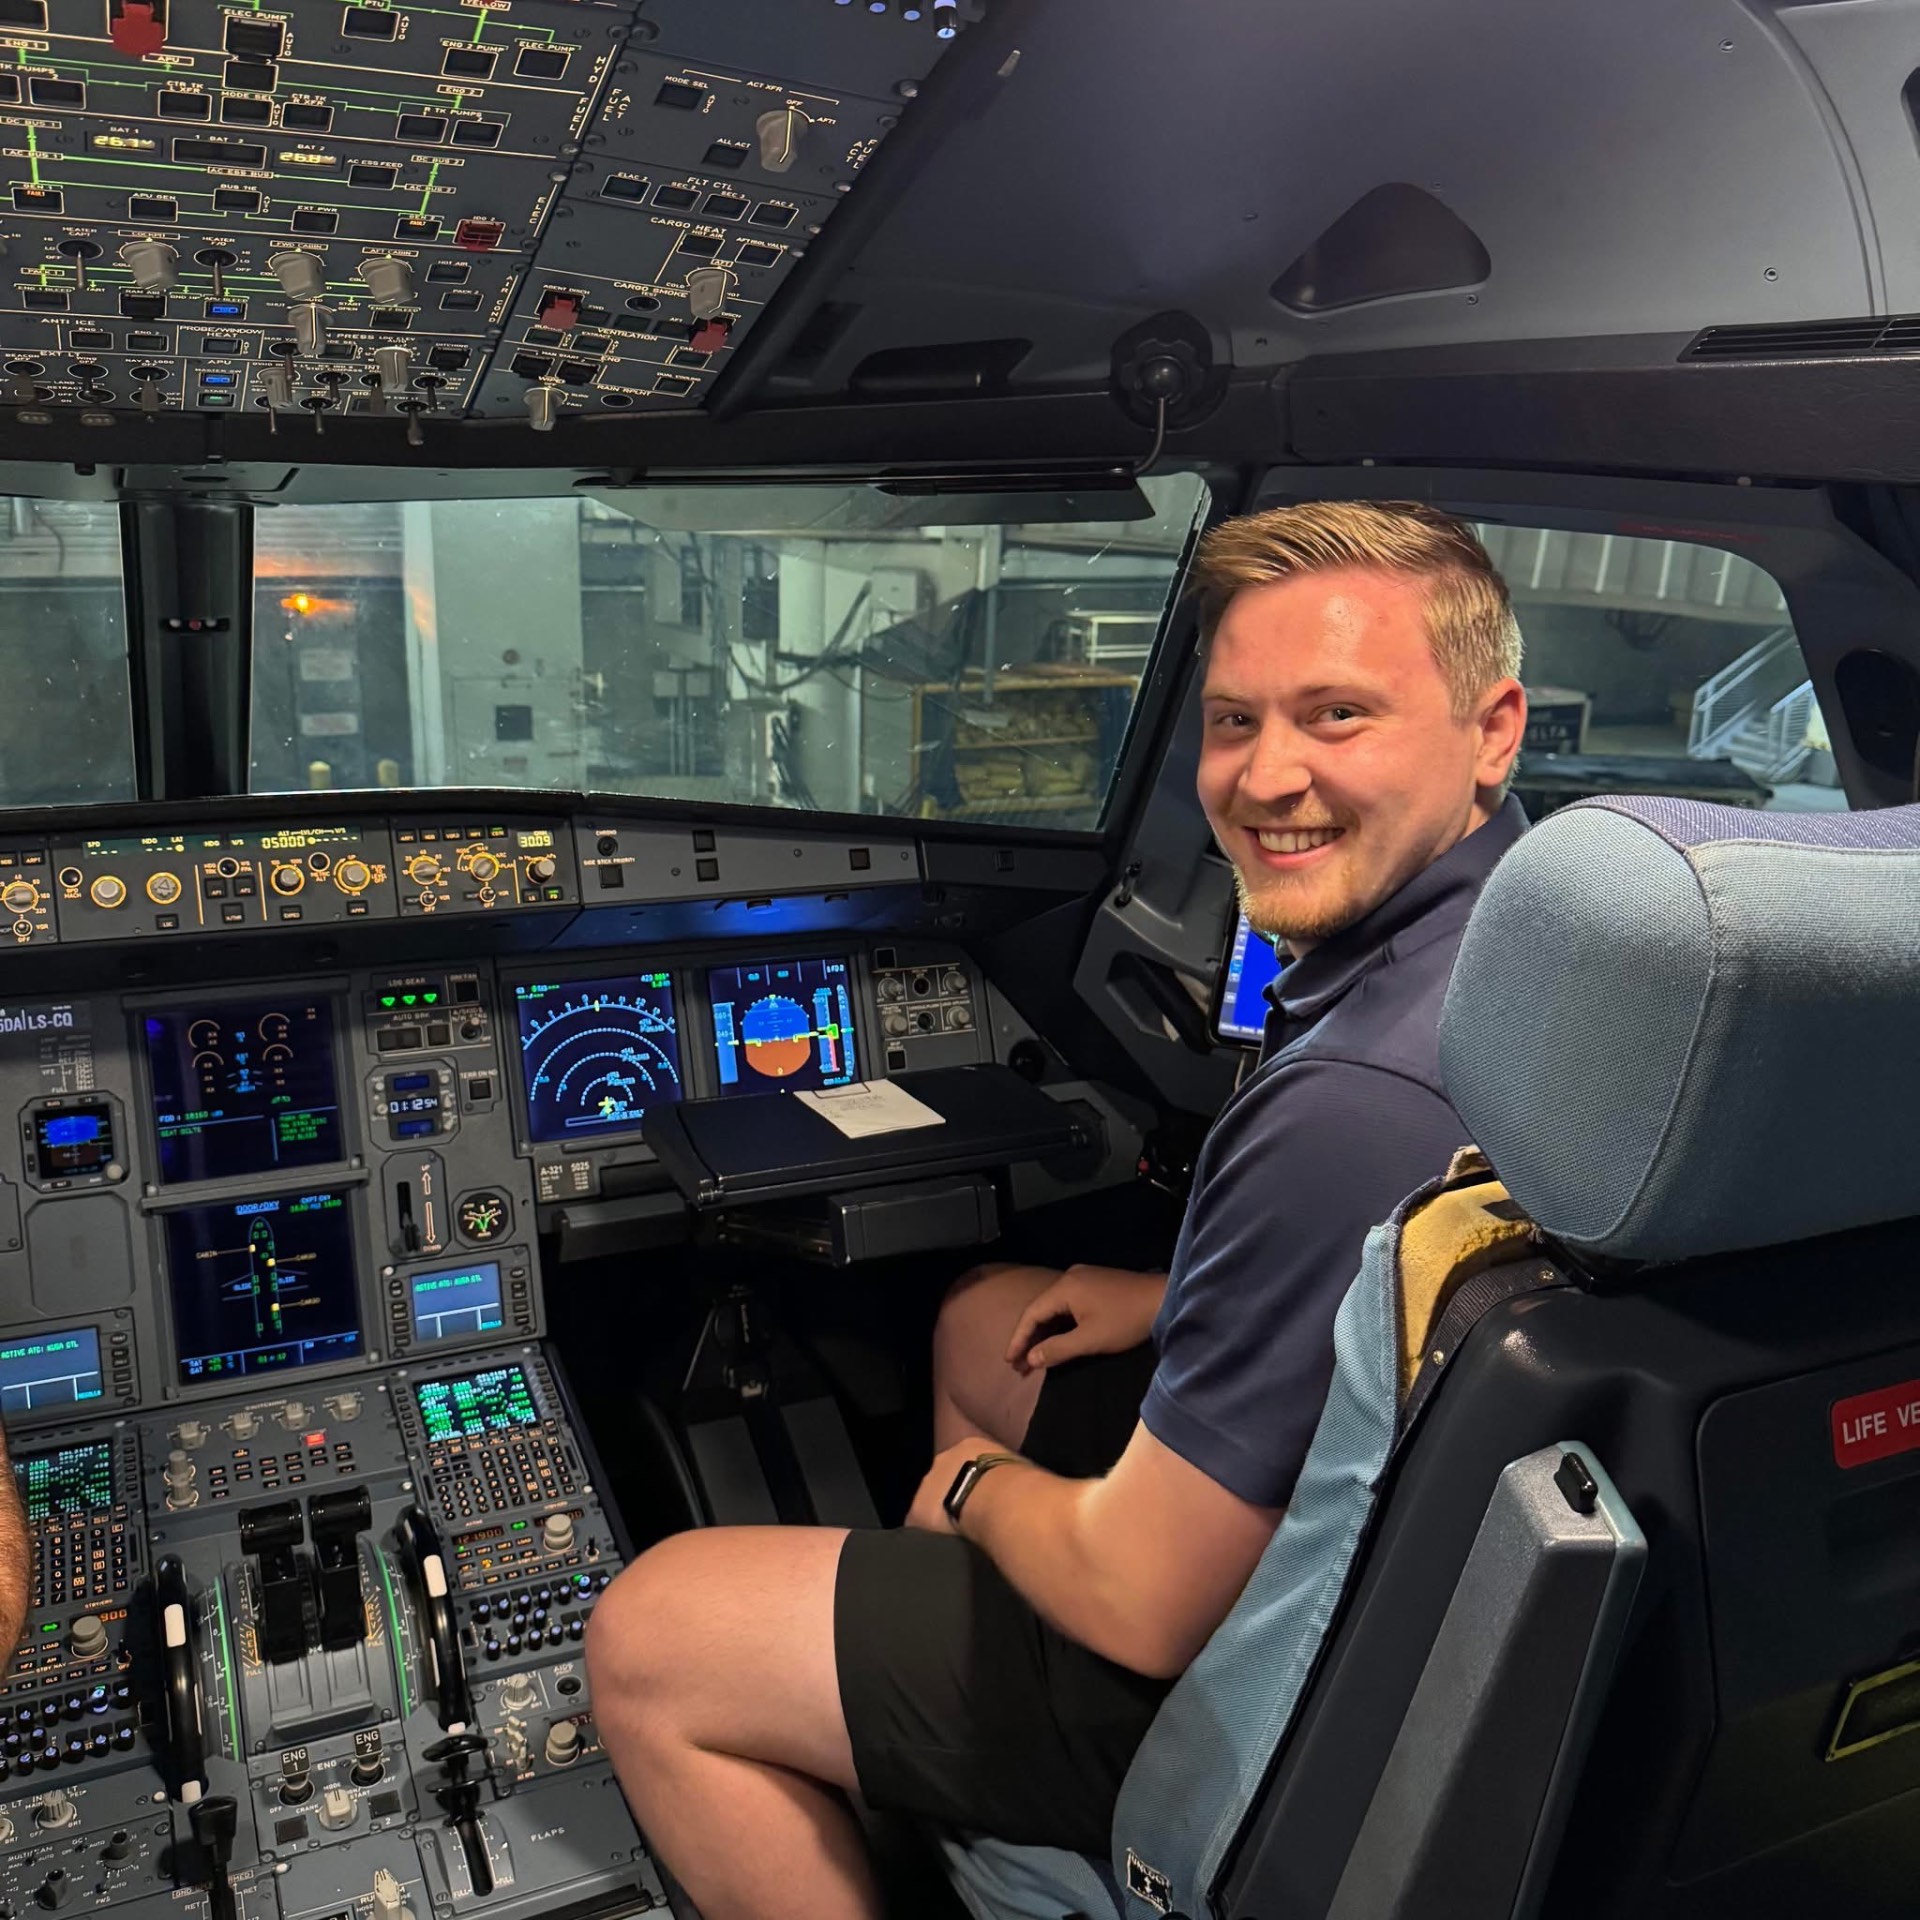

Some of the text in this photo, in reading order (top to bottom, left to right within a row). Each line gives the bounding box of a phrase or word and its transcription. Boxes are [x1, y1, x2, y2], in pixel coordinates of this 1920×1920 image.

[224, 9, 288, 20] ELEC PUMP
[442, 40, 462, 48] ENG
[477, 44, 504, 53] PUMP
[519, 41, 575, 52] ELEC PUMP
[17, 65, 56, 74] PUMPS
[588, 56, 607, 82] HYD
[665, 75, 709, 89] MODE SEL
[747, 81, 783, 92] ACT XFR
[602, 88, 622, 121] FUEL
[617, 94, 631, 119] ACT
[786, 99, 803, 107] OFF
[569, 97, 588, 131] FUEL
[735, 140, 751, 148] ACT
[845, 141, 863, 163] ACT
[852, 139, 878, 170] FUEL
[618, 172, 639, 180] ELAC
[687, 177, 733, 191] FLT CTL
[132, 192, 153, 200] APU
[529, 197, 547, 224] ELEC
[651, 217, 728, 235] CARGO HEAT
[613, 282, 688, 298] CARGO SMOKE
[180, 325, 263, 336] PROBE/WINDOW
[207, 331, 238, 339] HEAT
[597, 328, 658, 342] VENTILATION
[40, 350, 63, 358] EXT
[601, 355, 621, 363] ENG
[597, 384, 652, 397] RAIN RPLNT
[87, 840, 100, 848] SPD
[261, 836, 305, 849] 05000
[28, 1012, 73, 1031] LS-CQ
[540, 1161, 590, 1176] A-321 5025
[1842, 1412, 1887, 1445] LIFE
[368, 1604, 376, 1630] REV
[43, 1642, 59, 1650] LOAD
[355, 1731, 379, 1744] ENG
[365, 1742, 372, 1753] 2
[282, 1749, 307, 1764] ENG
[293, 1762, 299, 1771] 1
[317, 1760, 337, 1771] ENG
[383, 1776, 396, 1784] OFF
[295, 1804, 319, 1814] CRANK
[385, 1817, 391, 1826] 2
[531, 1827, 565, 1842] FLAPS
[89, 1840, 105, 1848] AUTO
[243, 1886, 258, 1895] RET
[185, 1901, 201, 1911] RET
[357, 1904, 374, 1913] NOSE
